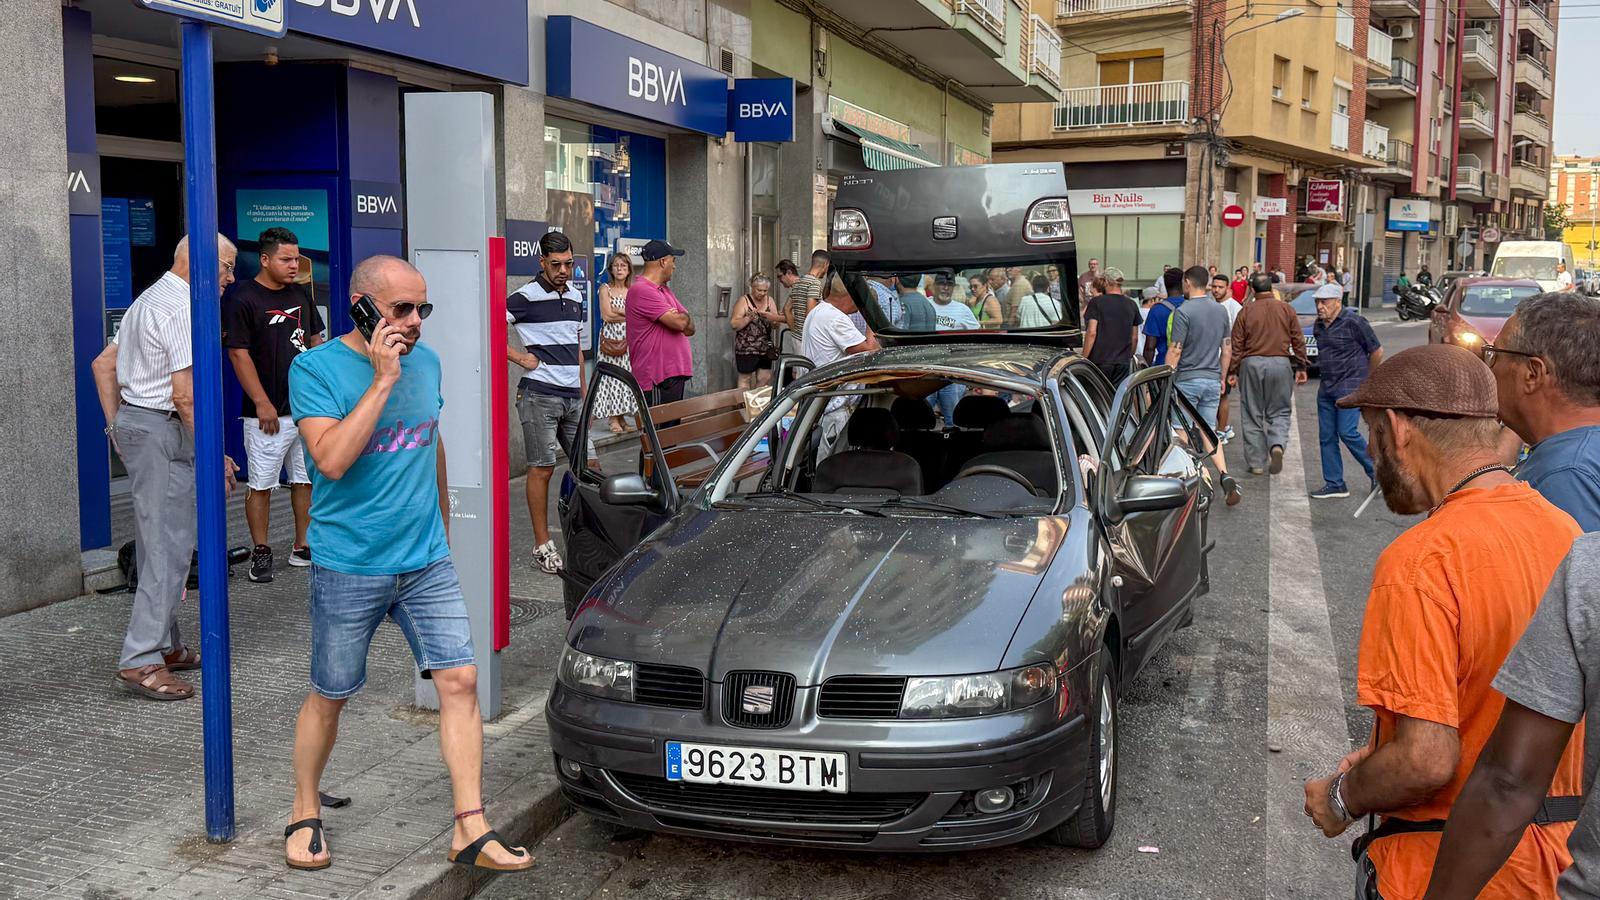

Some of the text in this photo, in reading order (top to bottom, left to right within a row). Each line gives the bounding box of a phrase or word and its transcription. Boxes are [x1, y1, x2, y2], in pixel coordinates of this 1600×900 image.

[628, 56, 687, 106] BBVA
[739, 101, 788, 118] BBVA
[357, 195, 398, 214] BBVA
[1093, 192, 1143, 203] Bin Nails
[513, 241, 543, 257] BBVA
[671, 764, 679, 773] E
[688, 748, 838, 788] 9623 BTM
